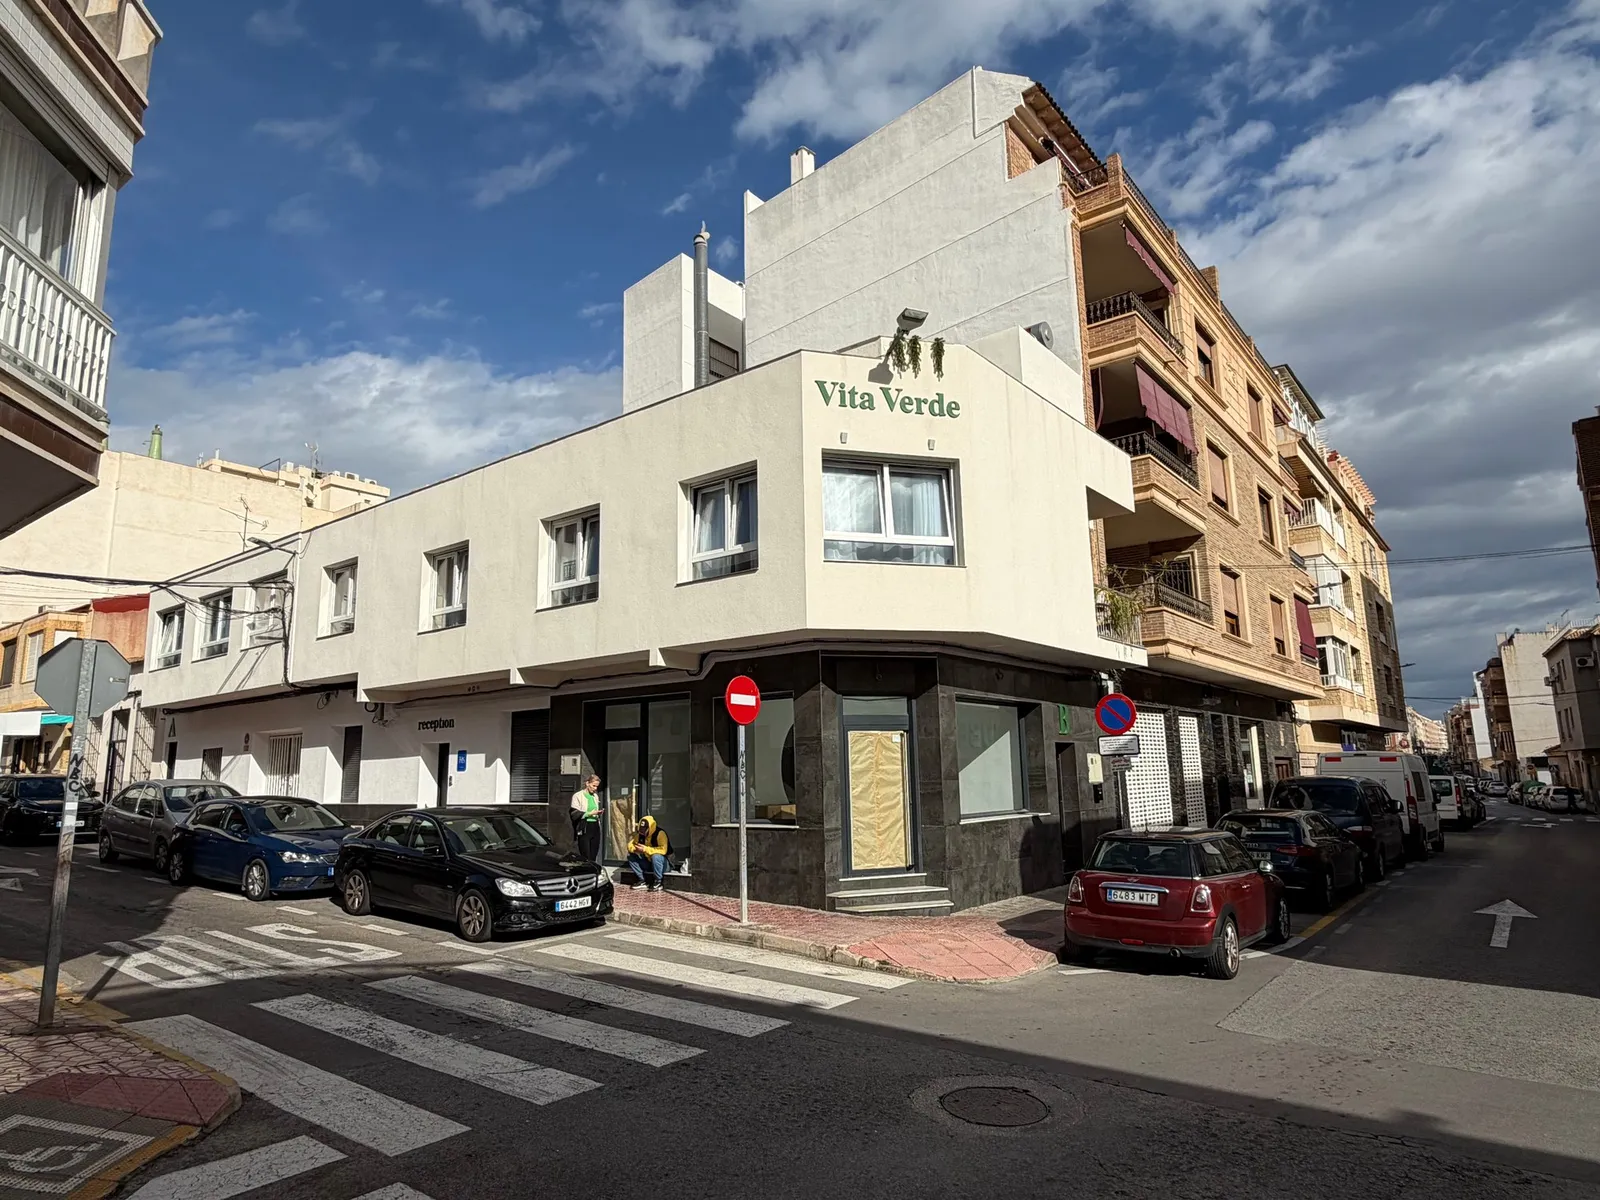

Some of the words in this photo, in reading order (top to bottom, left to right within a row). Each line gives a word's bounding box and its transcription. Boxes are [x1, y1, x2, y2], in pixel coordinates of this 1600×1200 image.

[814, 380, 876, 411] Vita
[879, 386, 961, 419] Verde
[418, 717, 455, 732] reception
[1057, 703, 1070, 735] B
[1113, 890, 1136, 901] 6483
[1138, 893, 1156, 903] MTP
[560, 900, 578, 910] 6442
